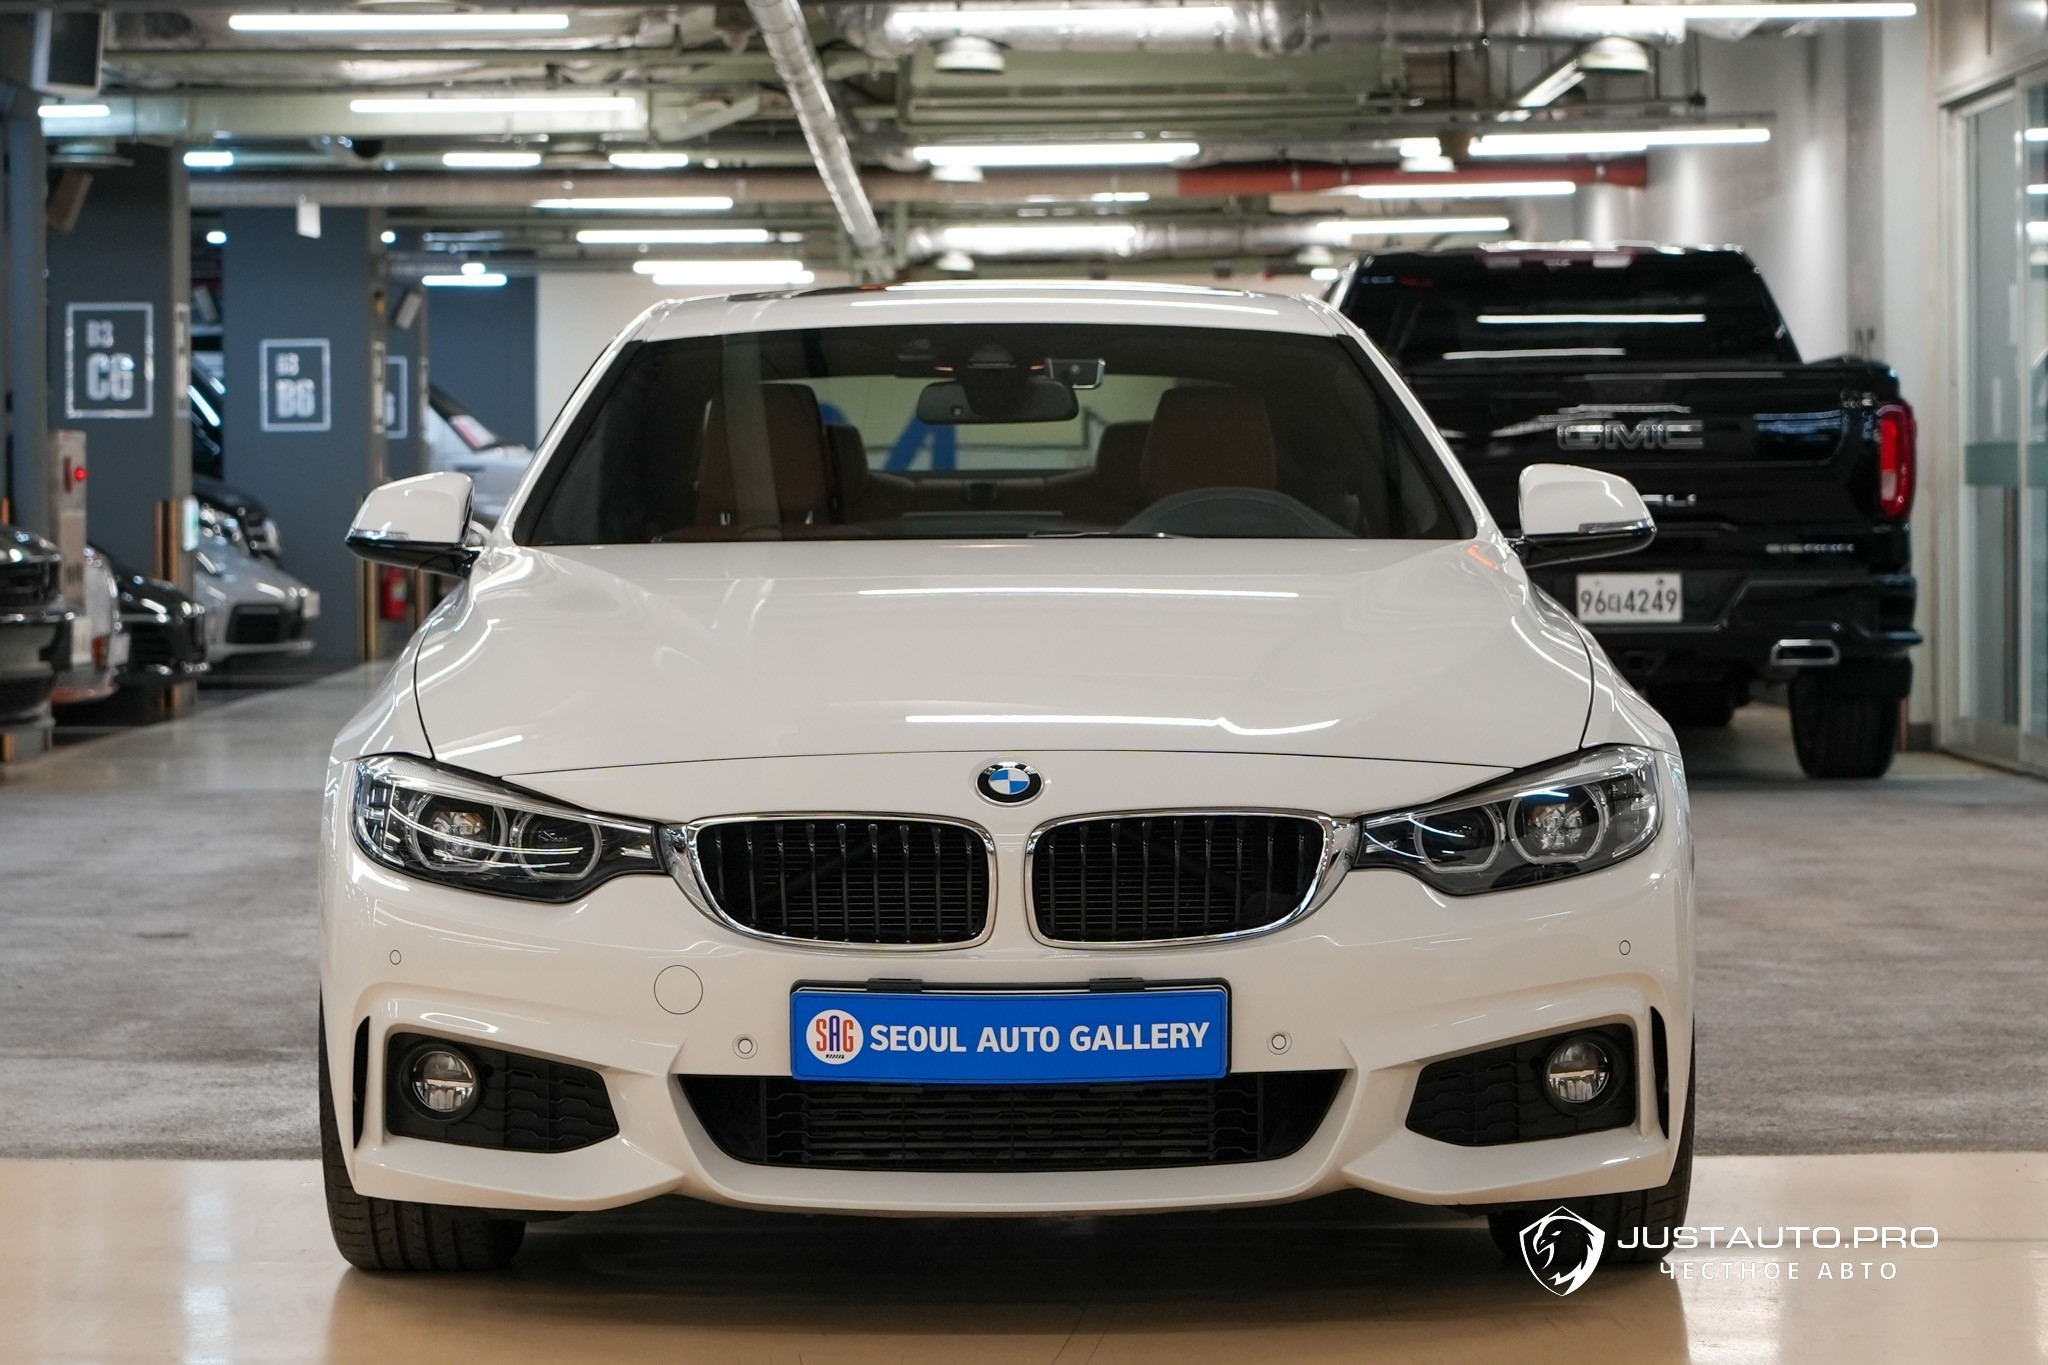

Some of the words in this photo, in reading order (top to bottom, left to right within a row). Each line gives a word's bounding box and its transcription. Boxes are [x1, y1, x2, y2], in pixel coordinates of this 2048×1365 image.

[1557, 420, 1704, 450] GMC
[816, 1015, 854, 1052] SAG
[869, 1024, 967, 1052] SEOUL
[976, 1026, 1060, 1053] AUTO
[1069, 1022, 1210, 1052] GALLERY
